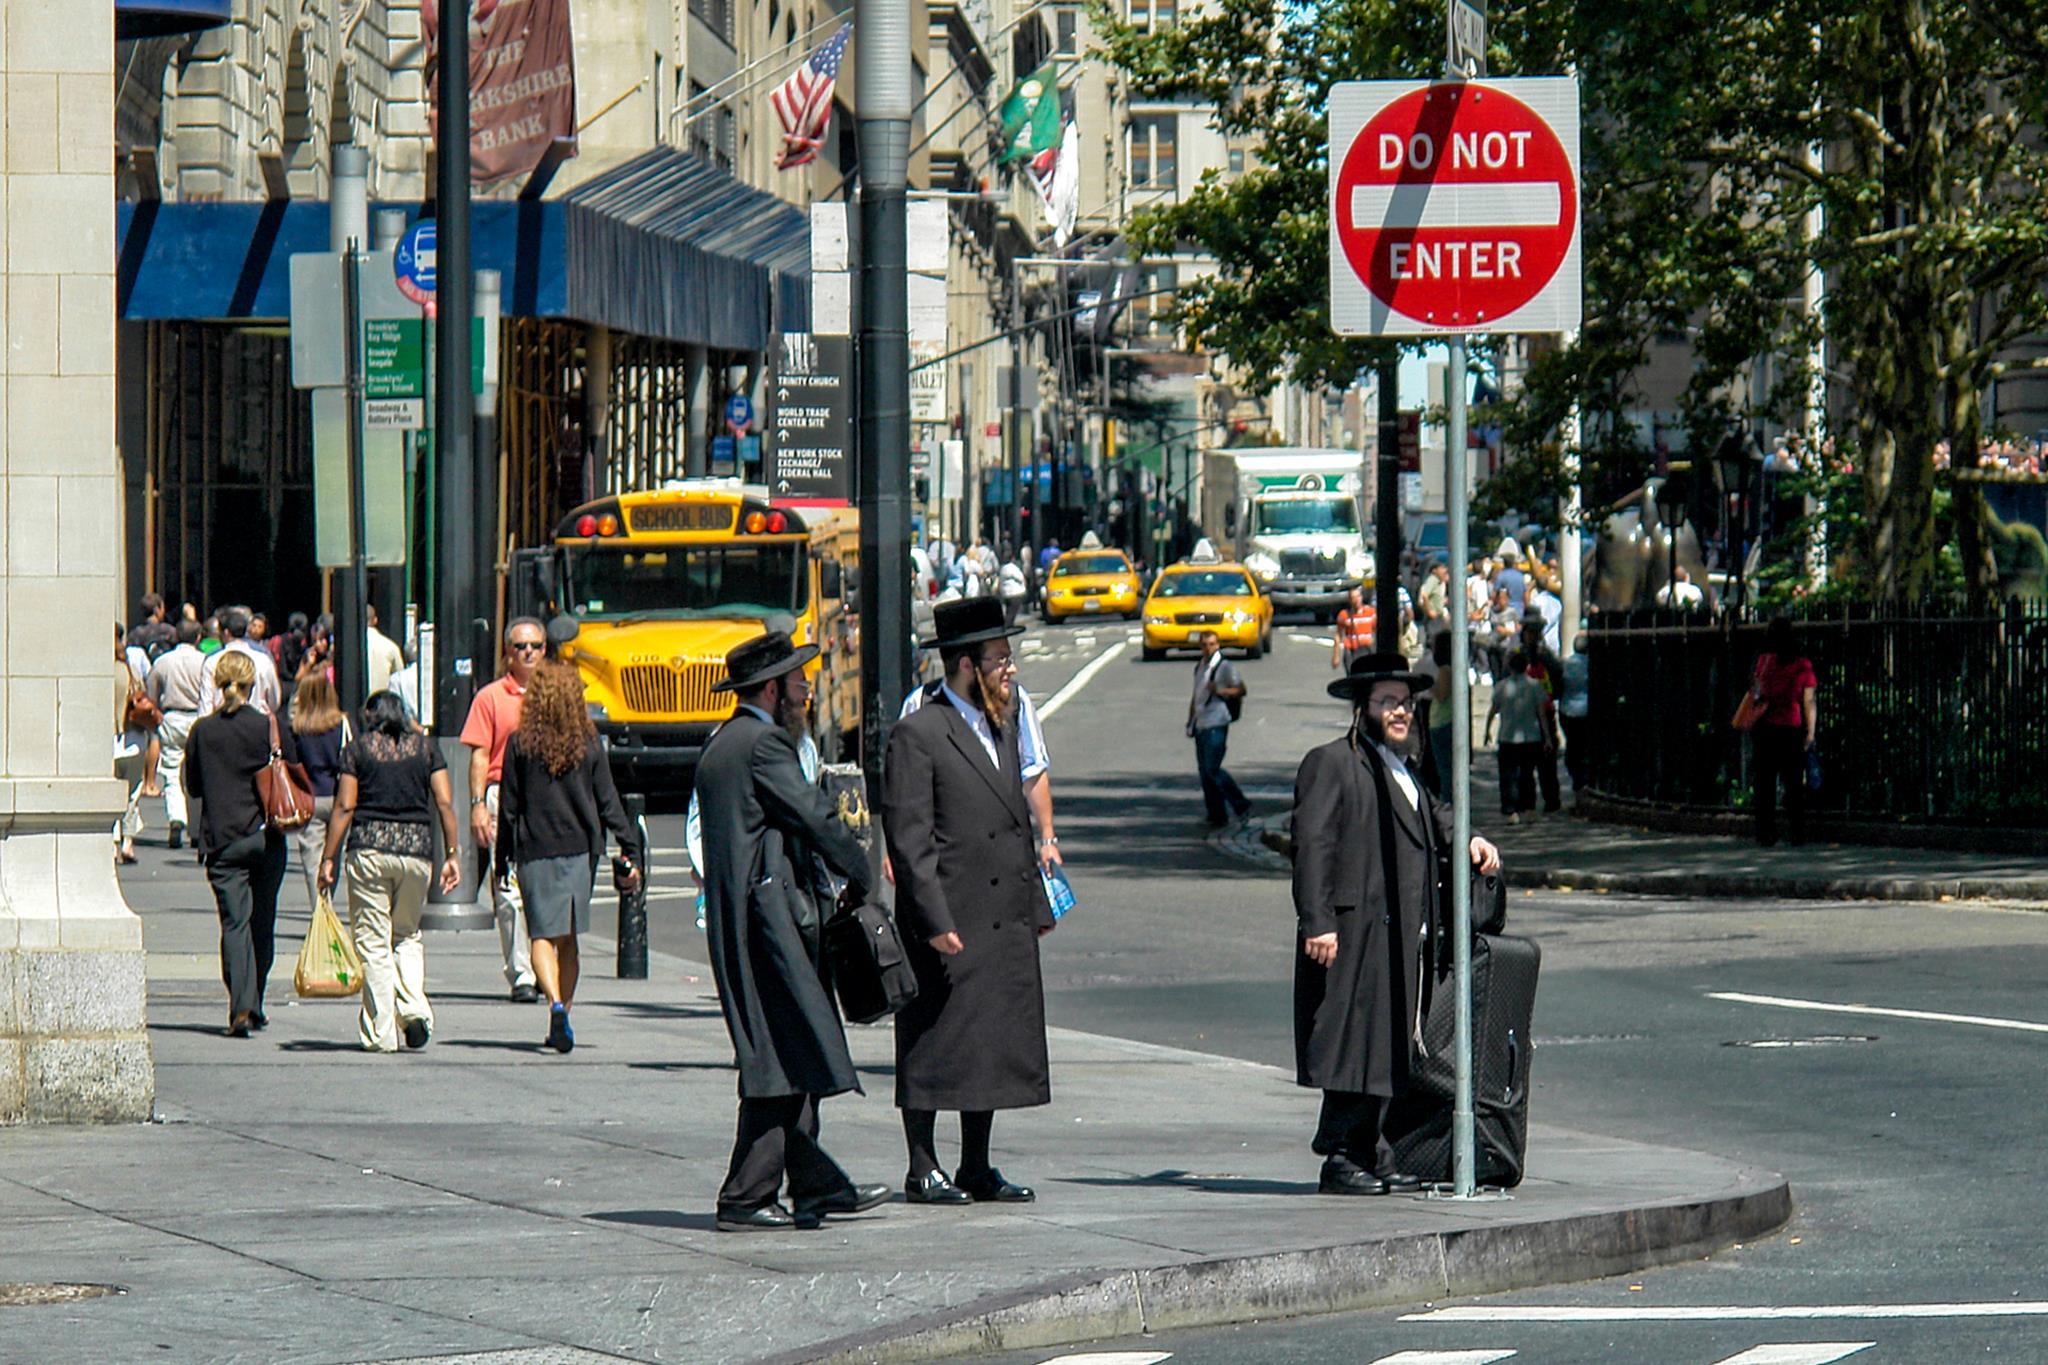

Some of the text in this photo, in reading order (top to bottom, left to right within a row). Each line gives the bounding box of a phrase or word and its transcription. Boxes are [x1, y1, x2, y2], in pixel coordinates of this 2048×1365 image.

[479, 113, 546, 150] BANK
[1378, 131, 1532, 170] DO NOT
[1390, 241, 1521, 280] ENTER
[777, 376, 840, 387] TRINITY CHURCH
[777, 408, 830, 418] WORLD TRADE
[777, 418, 825, 428] CENTER SITE
[777, 449, 842, 459] NEW YORK STOCK
[777, 458, 822, 468] EXCHANGE/
[777, 468, 832, 478] FEDERAL HALL
[633, 506, 730, 530] SCHOOL BUS
